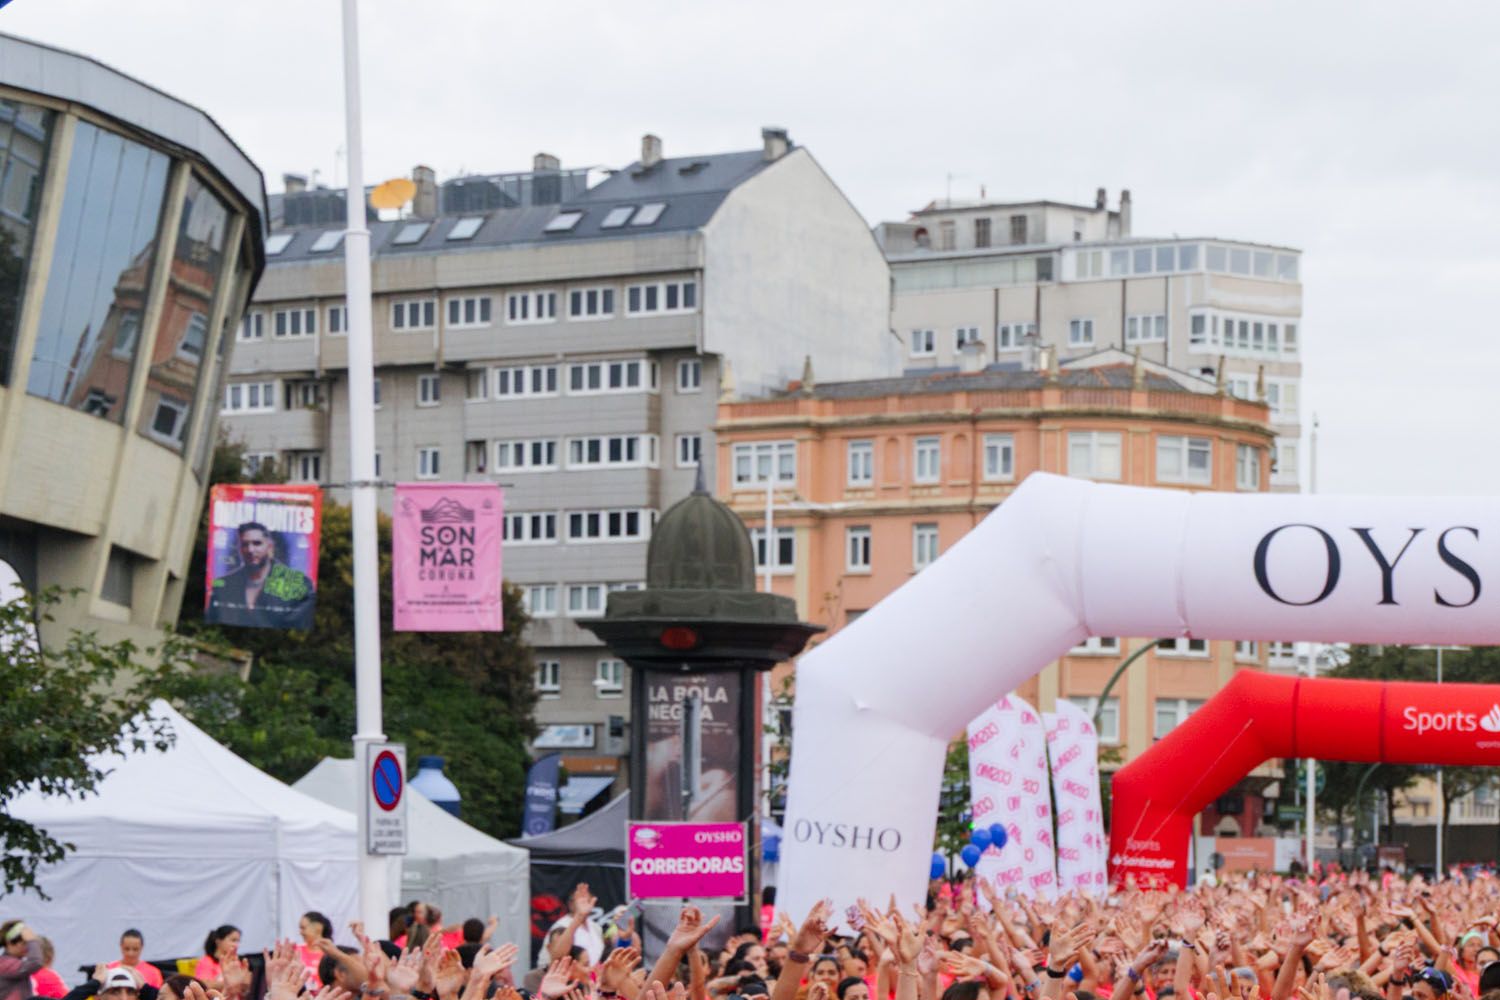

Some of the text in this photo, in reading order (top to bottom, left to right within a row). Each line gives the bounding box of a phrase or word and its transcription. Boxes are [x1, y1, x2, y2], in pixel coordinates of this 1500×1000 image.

[421, 526, 475, 546] SON
[420, 548, 475, 567] MAR
[648, 685, 728, 703] LA BOLA
[648, 703, 714, 721] NEGA
[1403, 706, 1477, 734] Sports
[694, 831, 743, 844] OYSHO
[794, 818, 902, 852] OYSHO
[630, 856, 744, 875] CORREDORAS
